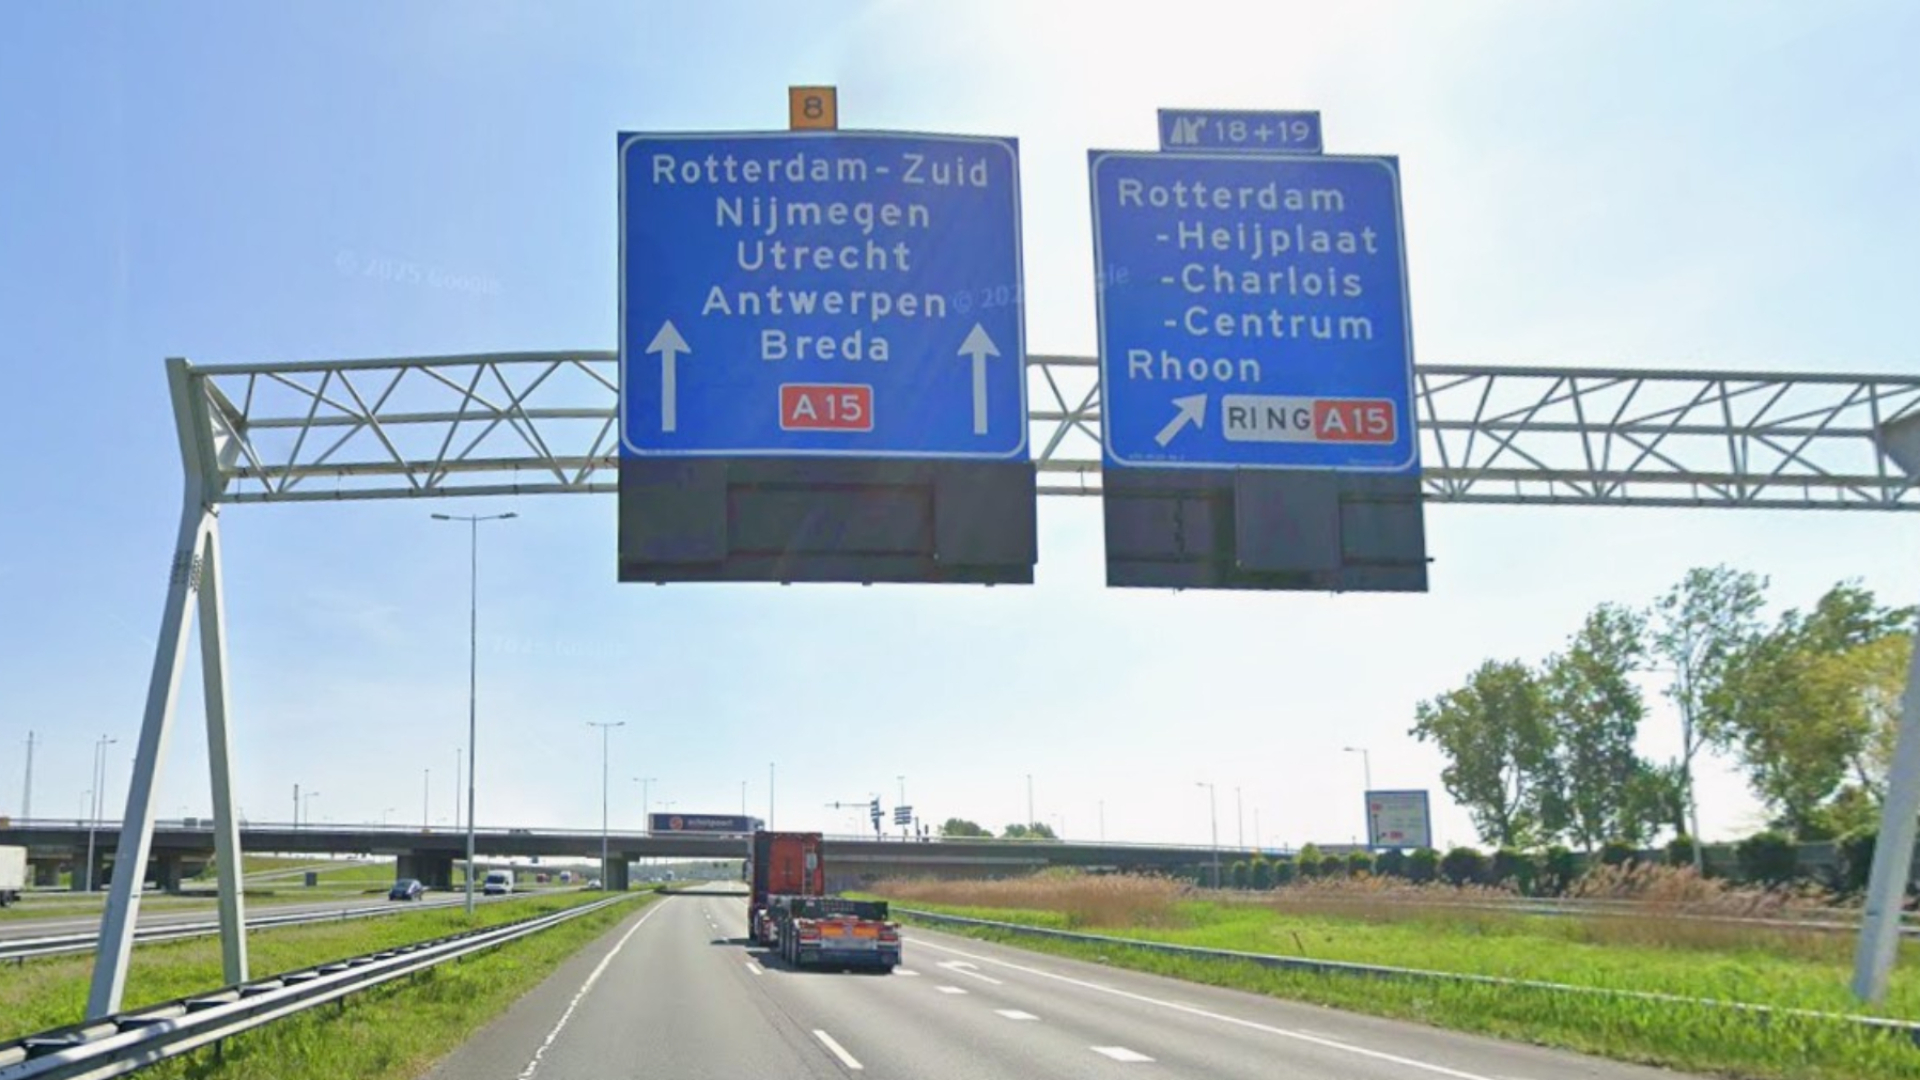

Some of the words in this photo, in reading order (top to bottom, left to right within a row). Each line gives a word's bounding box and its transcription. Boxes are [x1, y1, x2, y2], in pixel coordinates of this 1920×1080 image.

[804, 96, 823, 119] 8
[1216, 120, 1309, 142] 18+19
[1118, 178, 1345, 211] Rotterdam
[716, 197, 931, 235] Nijmegen
[738, 239, 911, 272] Utrecht
[1156, 221, 1379, 260] -Heijplaat
[1161, 263, 1362, 297] -Charlois
[702, 285, 946, 321] Antwerpen
[1164, 305, 1373, 339] -Centrum
[761, 329, 888, 361] Breda
[1128, 349, 1261, 382] Rhoon
[792, 394, 861, 421] A15
[1229, 406, 1311, 431] RING
[1323, 407, 1387, 434] A15
